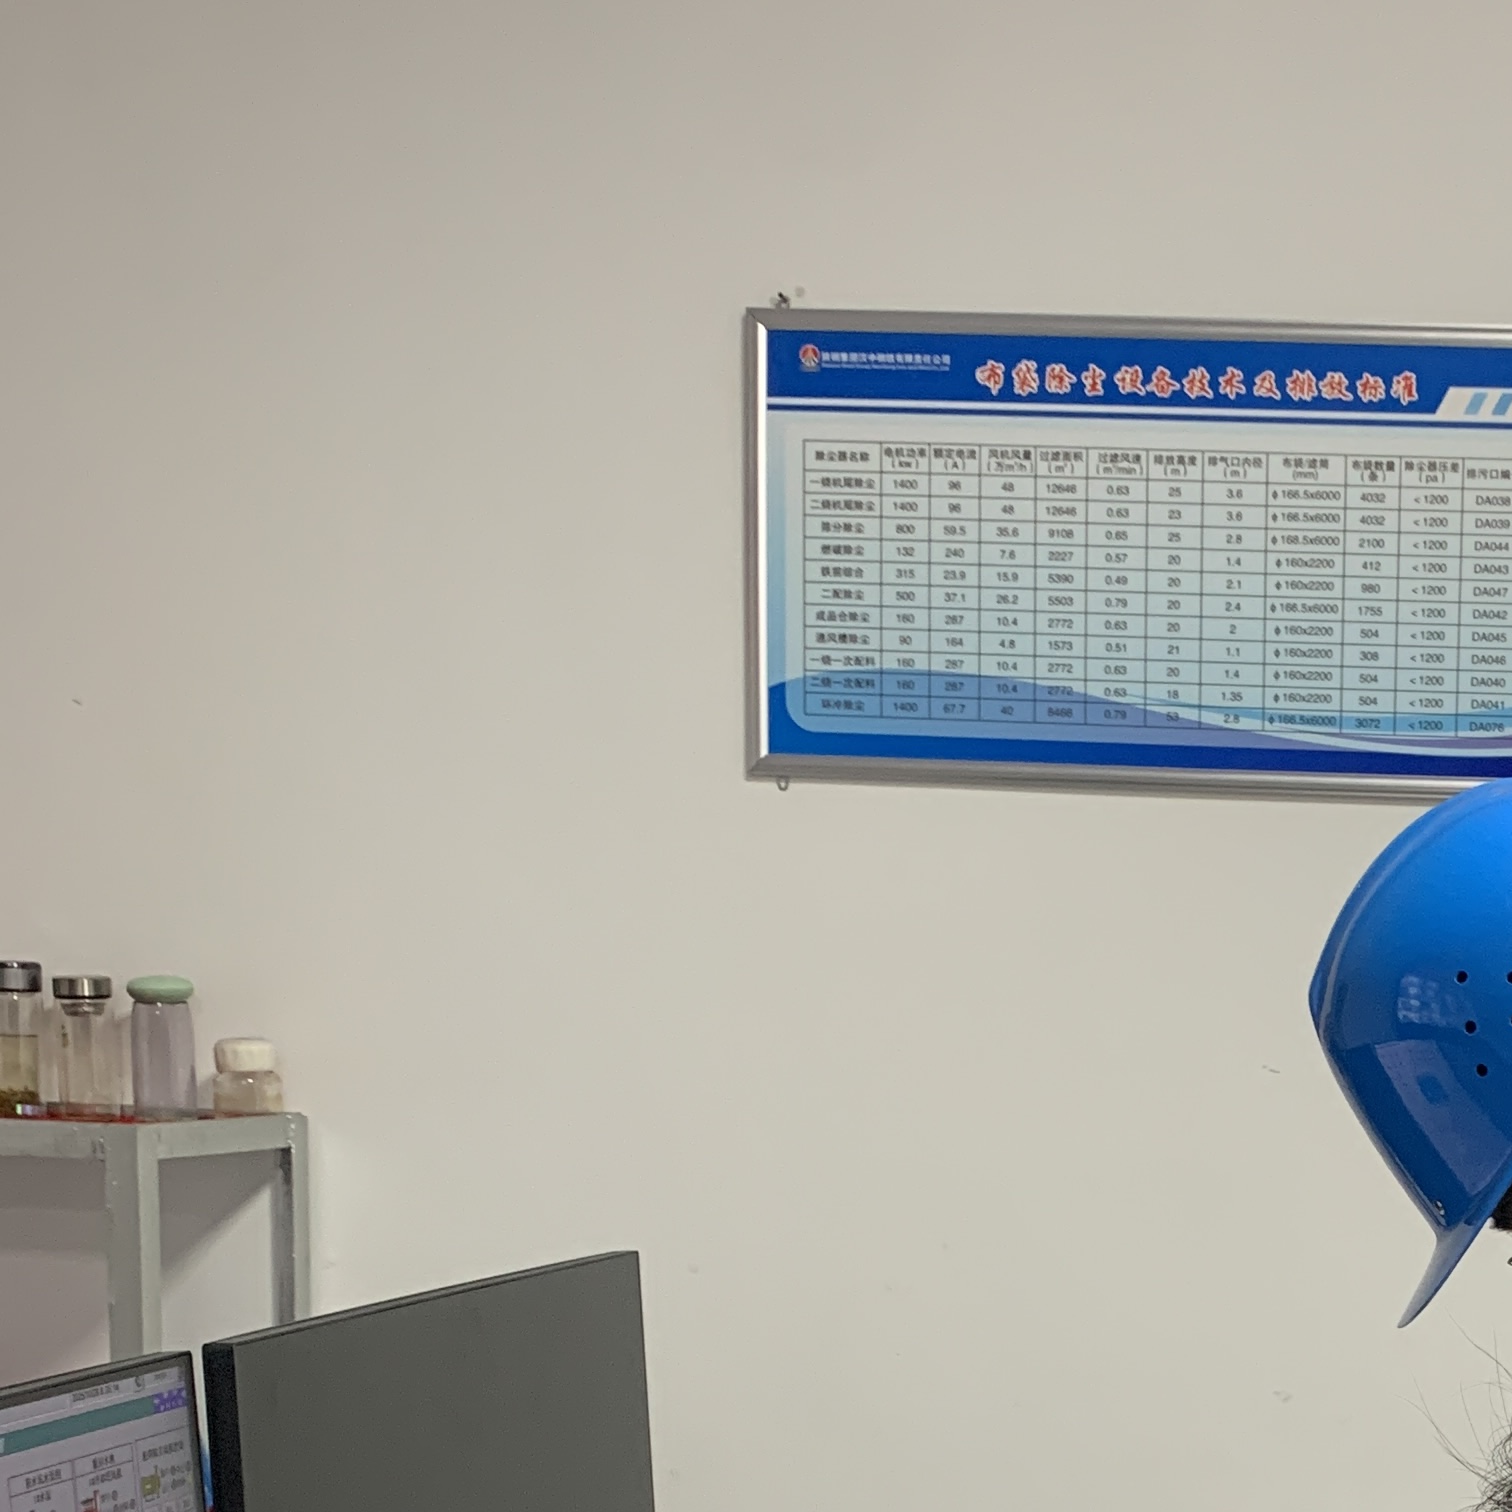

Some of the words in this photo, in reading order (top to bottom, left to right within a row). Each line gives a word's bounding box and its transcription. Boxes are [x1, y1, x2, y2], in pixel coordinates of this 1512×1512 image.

[975, 359, 1419, 406] 布袋除尘设备技术及排放标准
[1168, 487, 1182, 498] 25
[1226, 488, 1243, 499] 3.6
[1360, 493, 1386, 503] 4032
[1476, 495, 1511, 507] DA038
[1168, 509, 1182, 520] 23
[1226, 511, 1243, 522] 3.6
[1360, 515, 1385, 526] 4032
[1475, 518, 1510, 529] DA039
[1168, 532, 1181, 542] 25
[1226, 534, 1242, 544] 2.8
[1358, 538, 1385, 549] 2100
[1474, 541, 1509, 552] DA044
[1168, 555, 1181, 565] 20
[1226, 557, 1241, 566] 1.4
[1362, 561, 1381, 571] 412
[1474, 563, 1509, 575] DA043
[1167, 577, 1181, 588] 20
[1226, 579, 1241, 590] 2.1
[1361, 583, 1381, 594] 980
[1473, 586, 1508, 597] DA047
[1167, 600, 1181, 610] 20
[1225, 602, 1241, 612] 2.4
[1358, 606, 1383, 616] 1755
[1472, 609, 1508, 620] DA042
[1167, 622, 1180, 632] 20
[1229, 624, 1237, 635] 2
[1360, 628, 1379, 639] 504
[1472, 632, 1507, 643] DA045
[1167, 645, 1180, 655] 21
[1226, 647, 1240, 657] 1.1
[1360, 651, 1379, 661] 308
[1471, 654, 1506, 665] DA046
[1166, 667, 1180, 678] 20
[1225, 669, 1240, 679] 1.4
[1359, 673, 1378, 684] 504
[1470, 677, 1506, 688] DA040
[1222, 691, 1243, 702] 1.35
[1358, 696, 1377, 706] 504
[1471, 699, 1504, 710] DA041
[1223, 713, 1240, 724] 2.8
